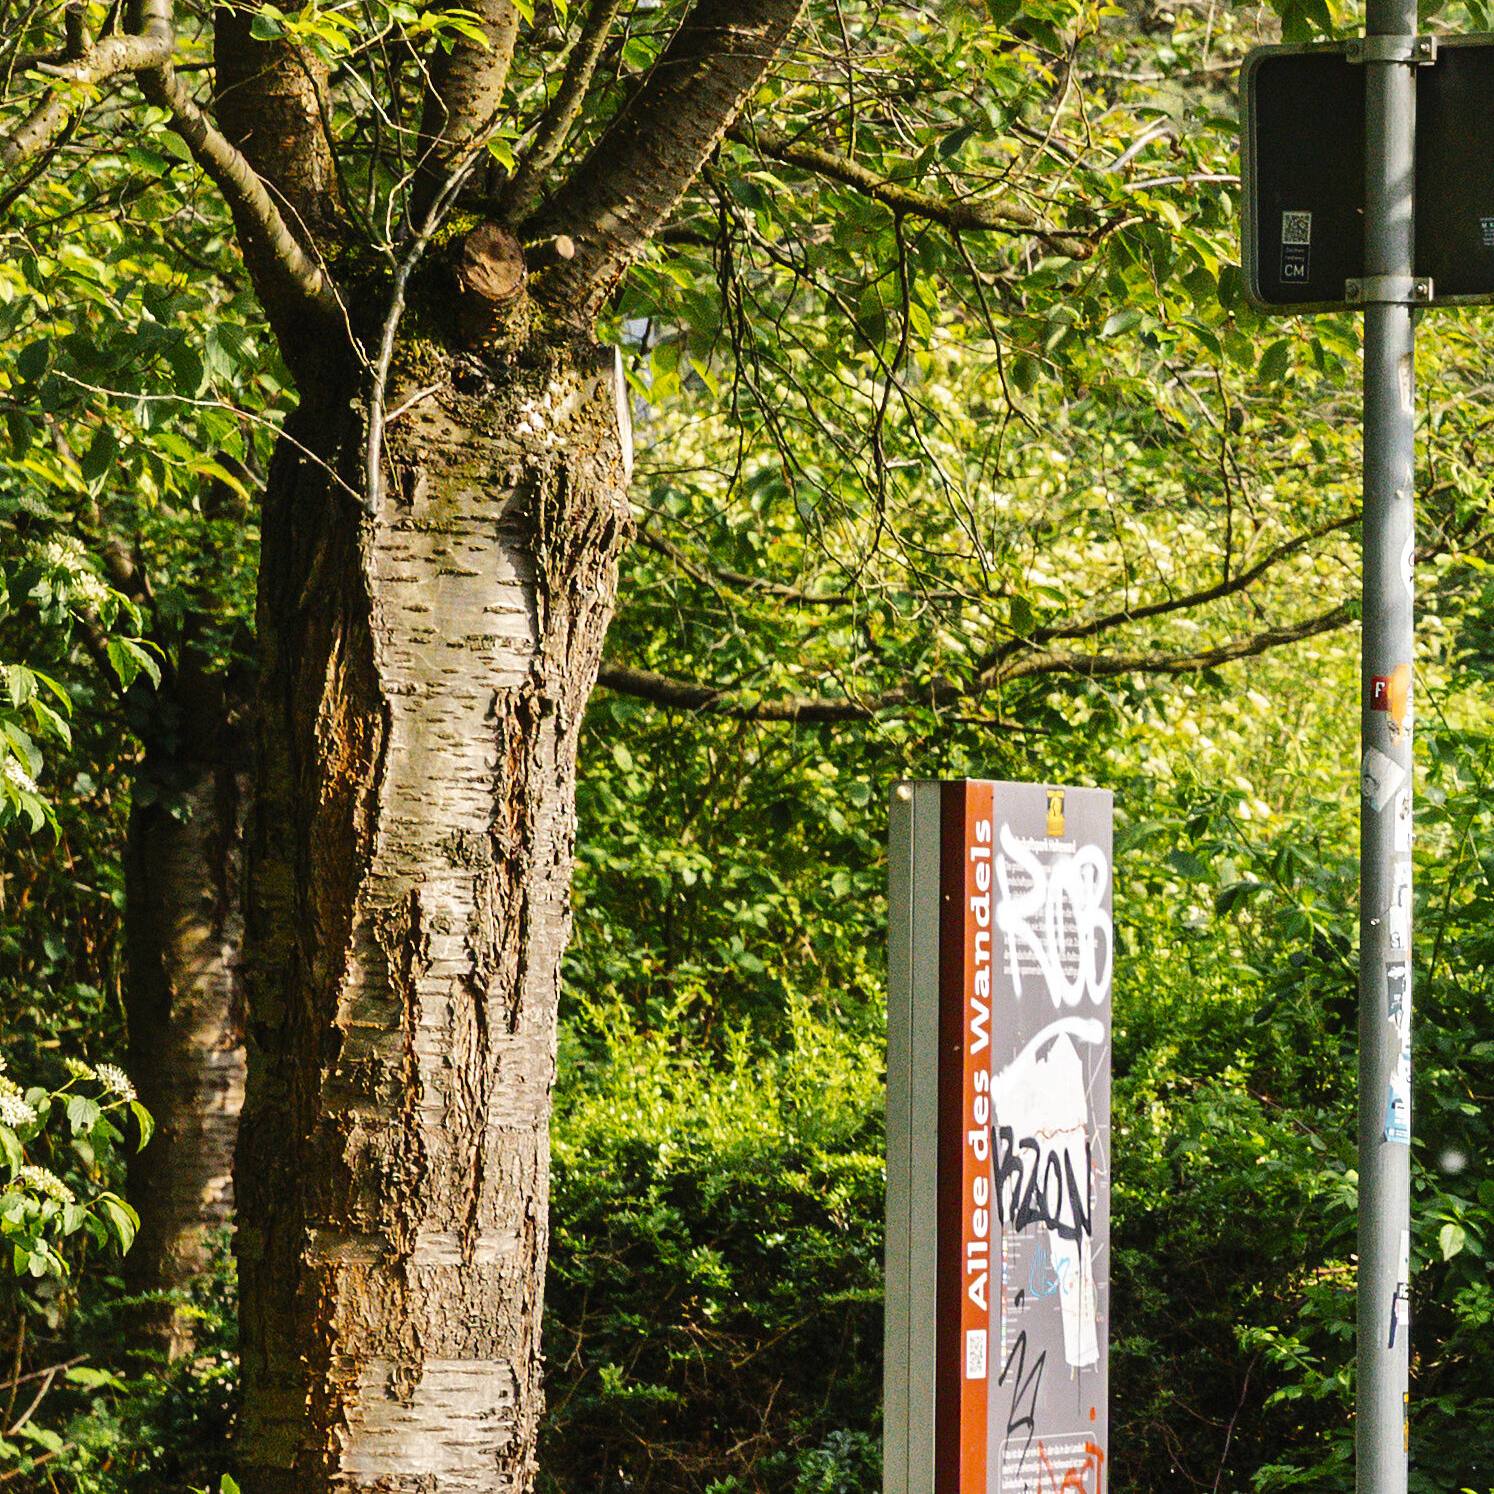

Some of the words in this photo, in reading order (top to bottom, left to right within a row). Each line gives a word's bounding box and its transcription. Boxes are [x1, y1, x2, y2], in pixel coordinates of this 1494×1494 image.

[1284, 264, 1304, 277] CM
[970, 819, 991, 1055] Wandels
[968, 1069, 989, 1161] des
[967, 1176, 989, 1312] Allee
